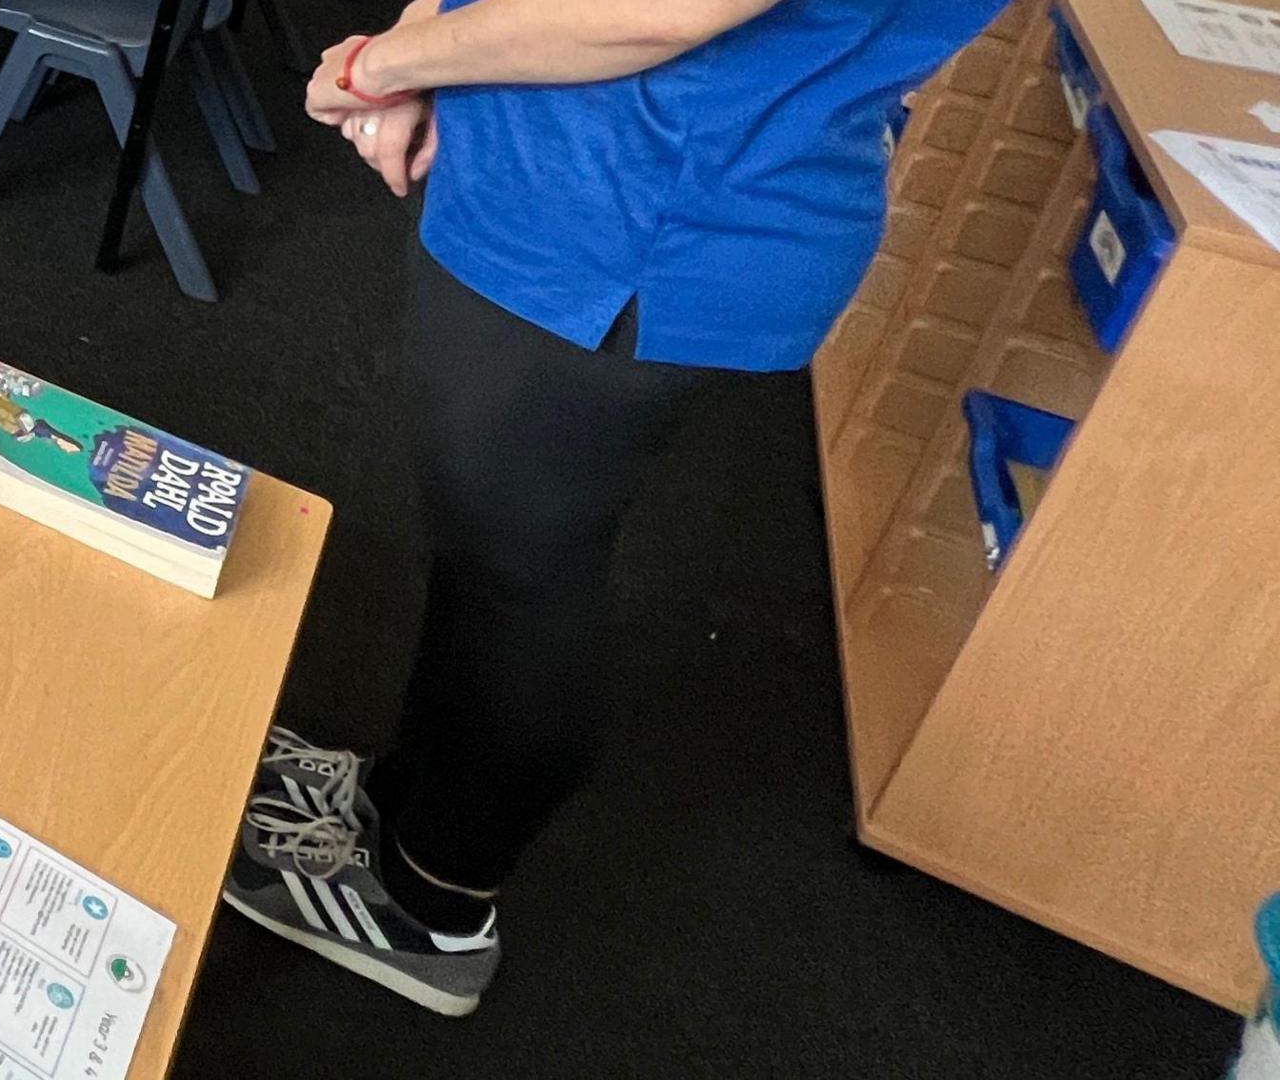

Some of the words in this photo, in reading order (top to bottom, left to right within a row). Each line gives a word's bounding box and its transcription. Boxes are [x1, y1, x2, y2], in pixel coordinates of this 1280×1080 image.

[103, 429, 159, 501] MATILDA
[142, 450, 201, 513] DAHL
[187, 461, 243, 537] ROALD
